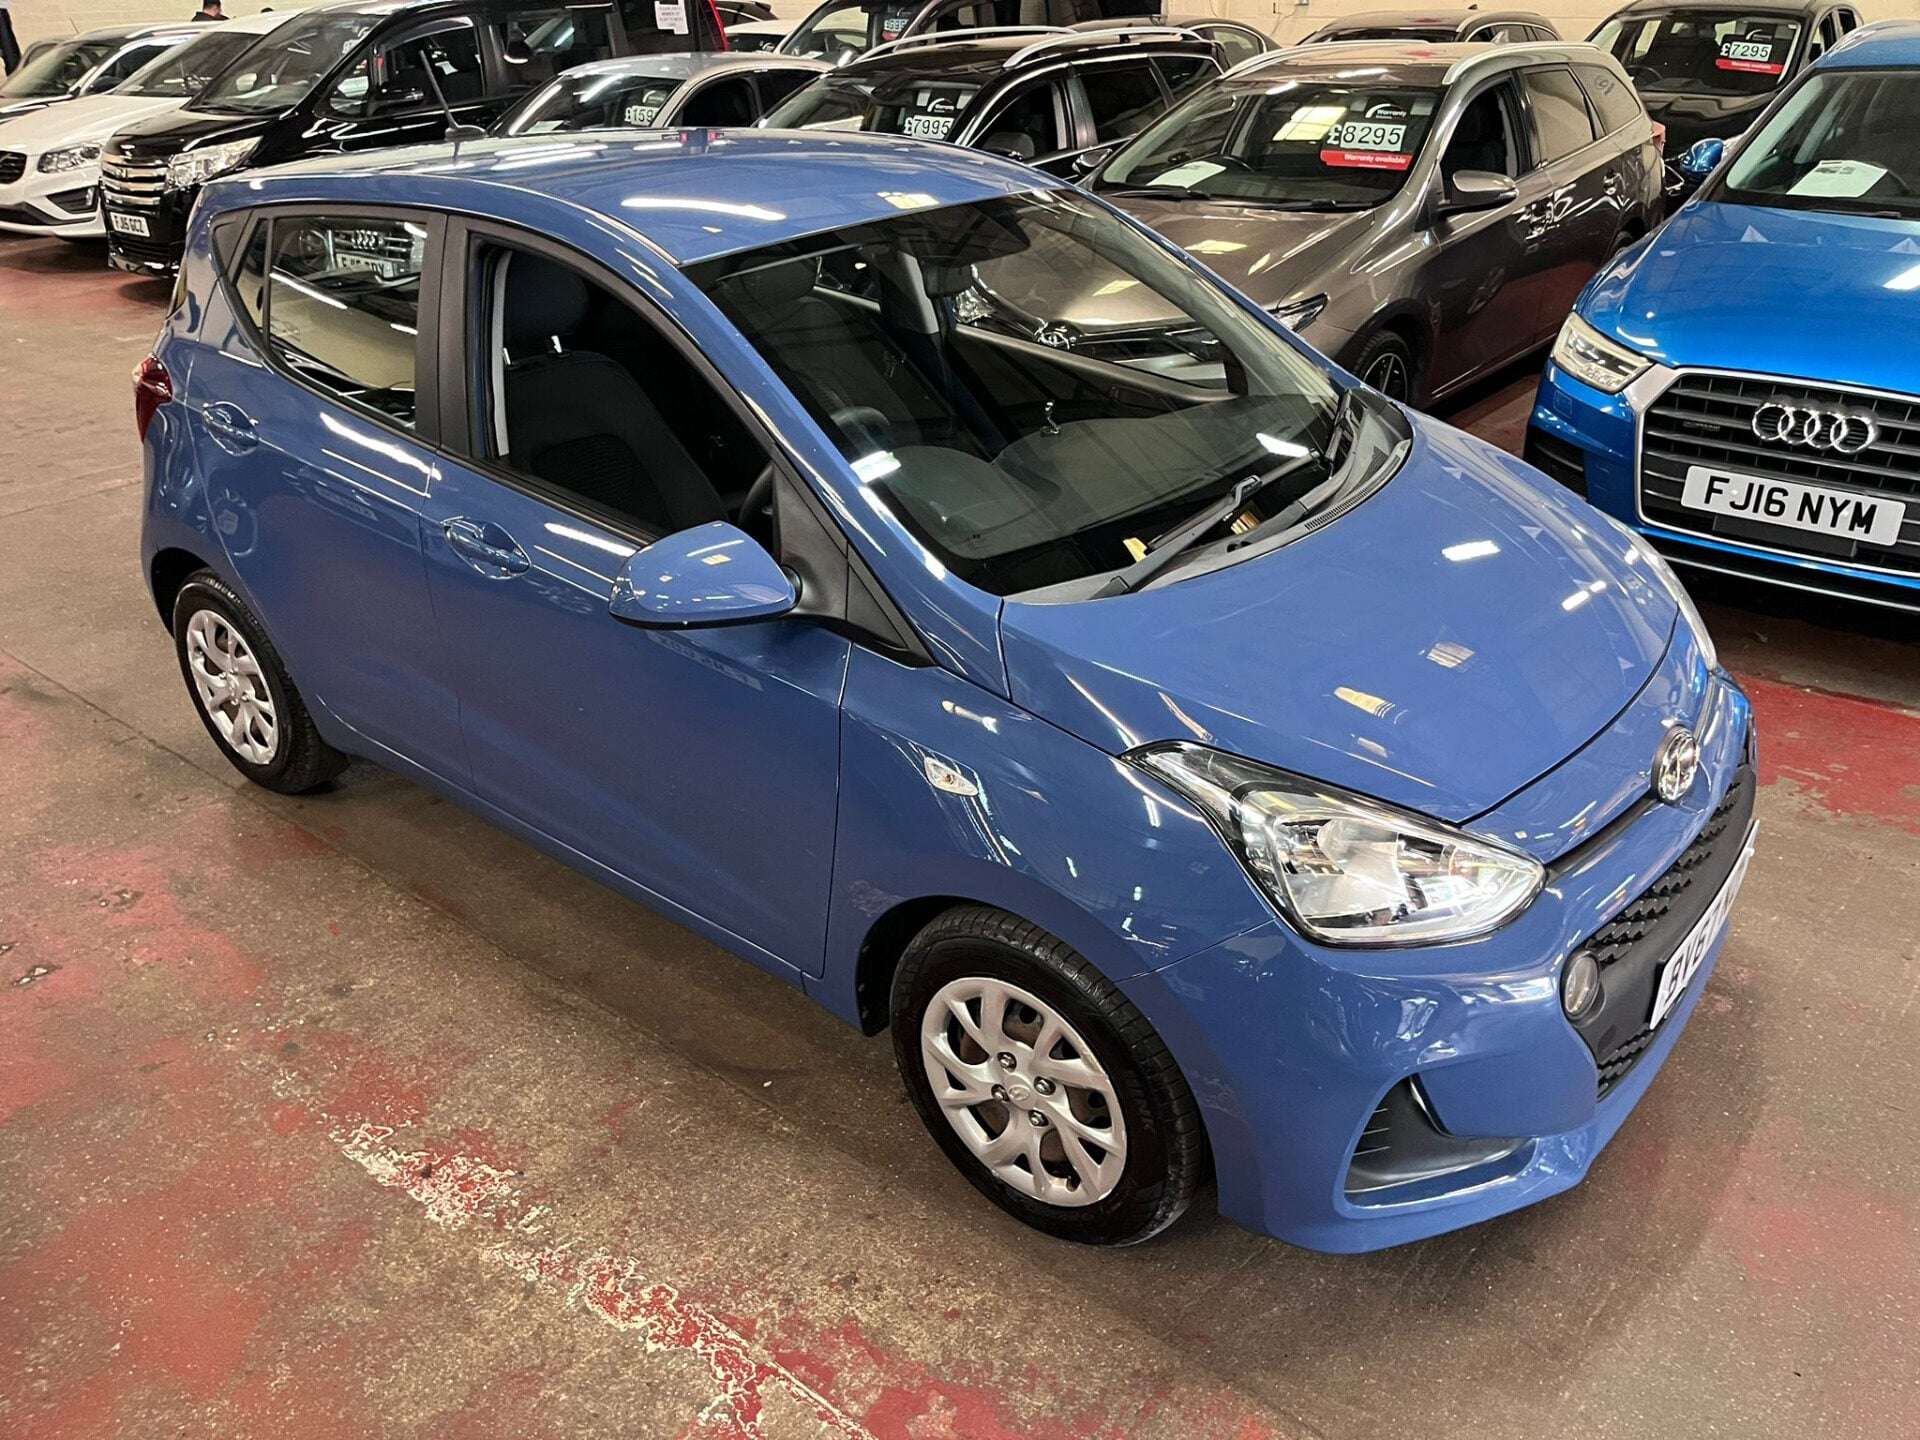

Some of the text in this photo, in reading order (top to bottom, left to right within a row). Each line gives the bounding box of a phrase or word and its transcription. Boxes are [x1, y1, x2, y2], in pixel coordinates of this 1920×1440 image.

[1720, 43, 1769, 58] £7295
[903, 117, 951, 136] £7995
[1326, 124, 1402, 145] £8295
[1704, 475, 1877, 534] FJ16 NYM
